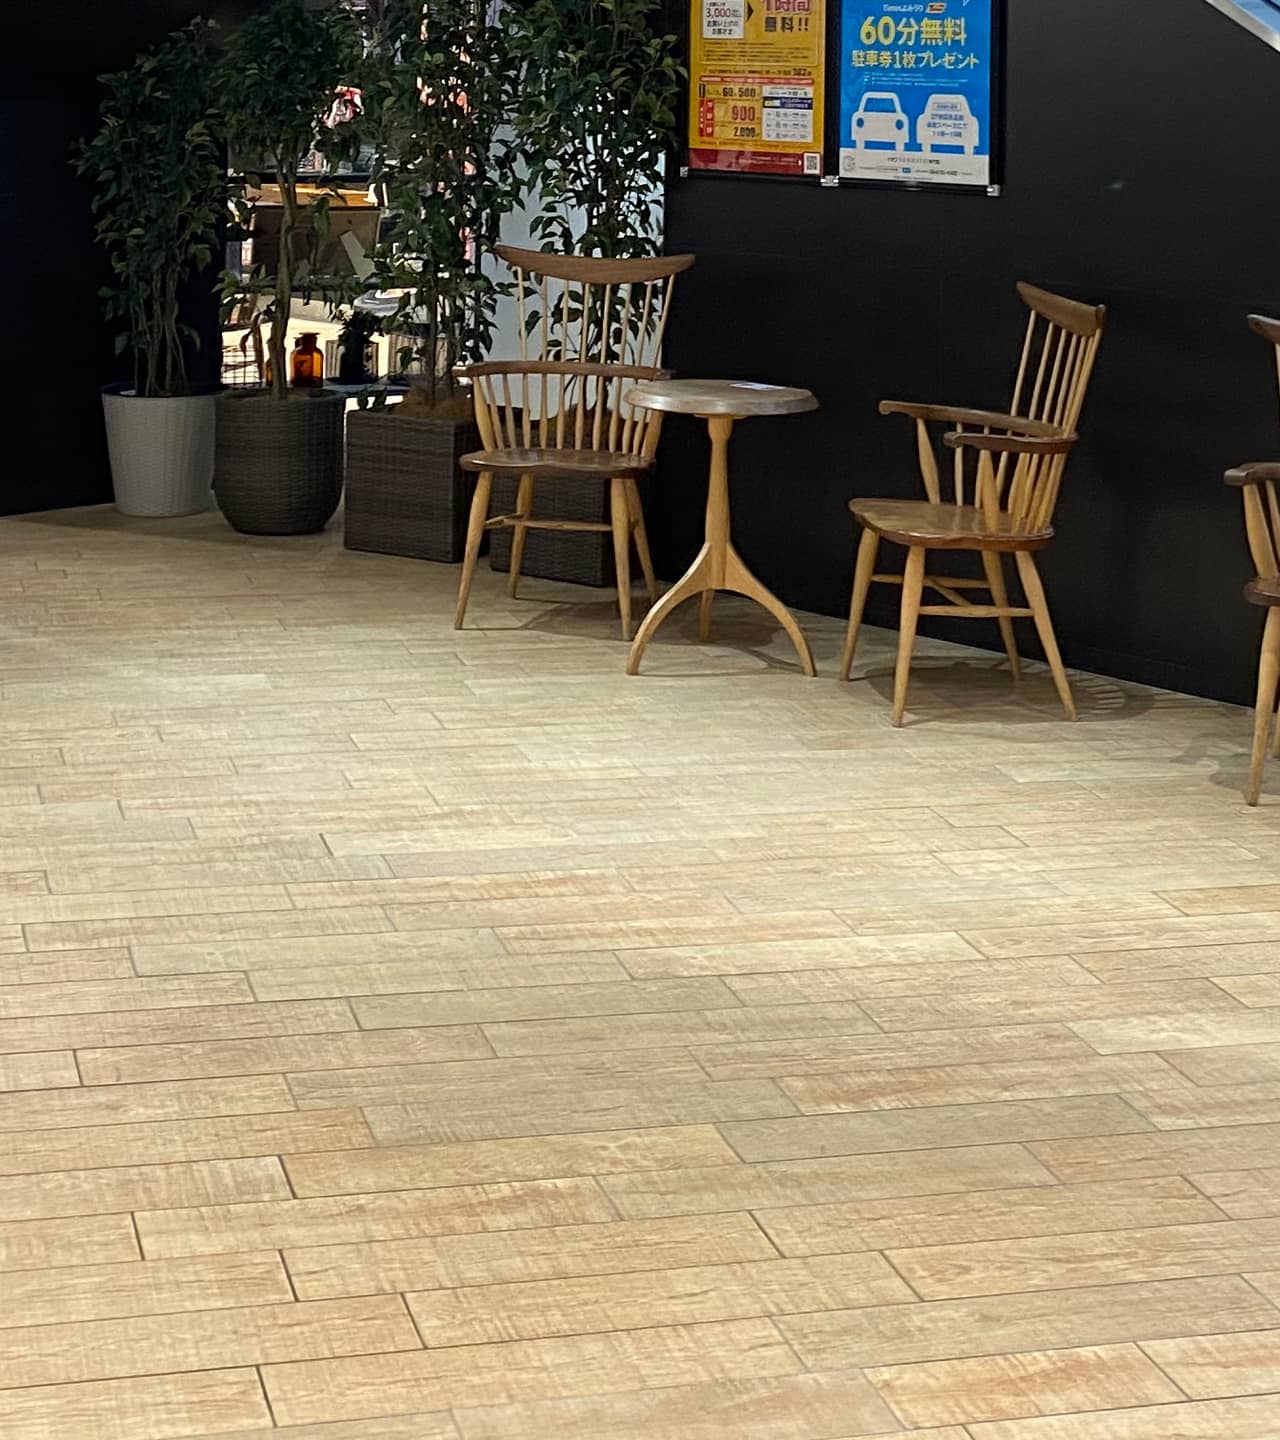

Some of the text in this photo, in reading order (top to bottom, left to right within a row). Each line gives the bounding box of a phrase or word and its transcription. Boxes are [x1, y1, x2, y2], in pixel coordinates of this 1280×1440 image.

[705, 8, 731, 19] 3,000
[860, 15, 967, 47] 60分無料
[851, 49, 980, 69] 駐車券1枚プレゼント
